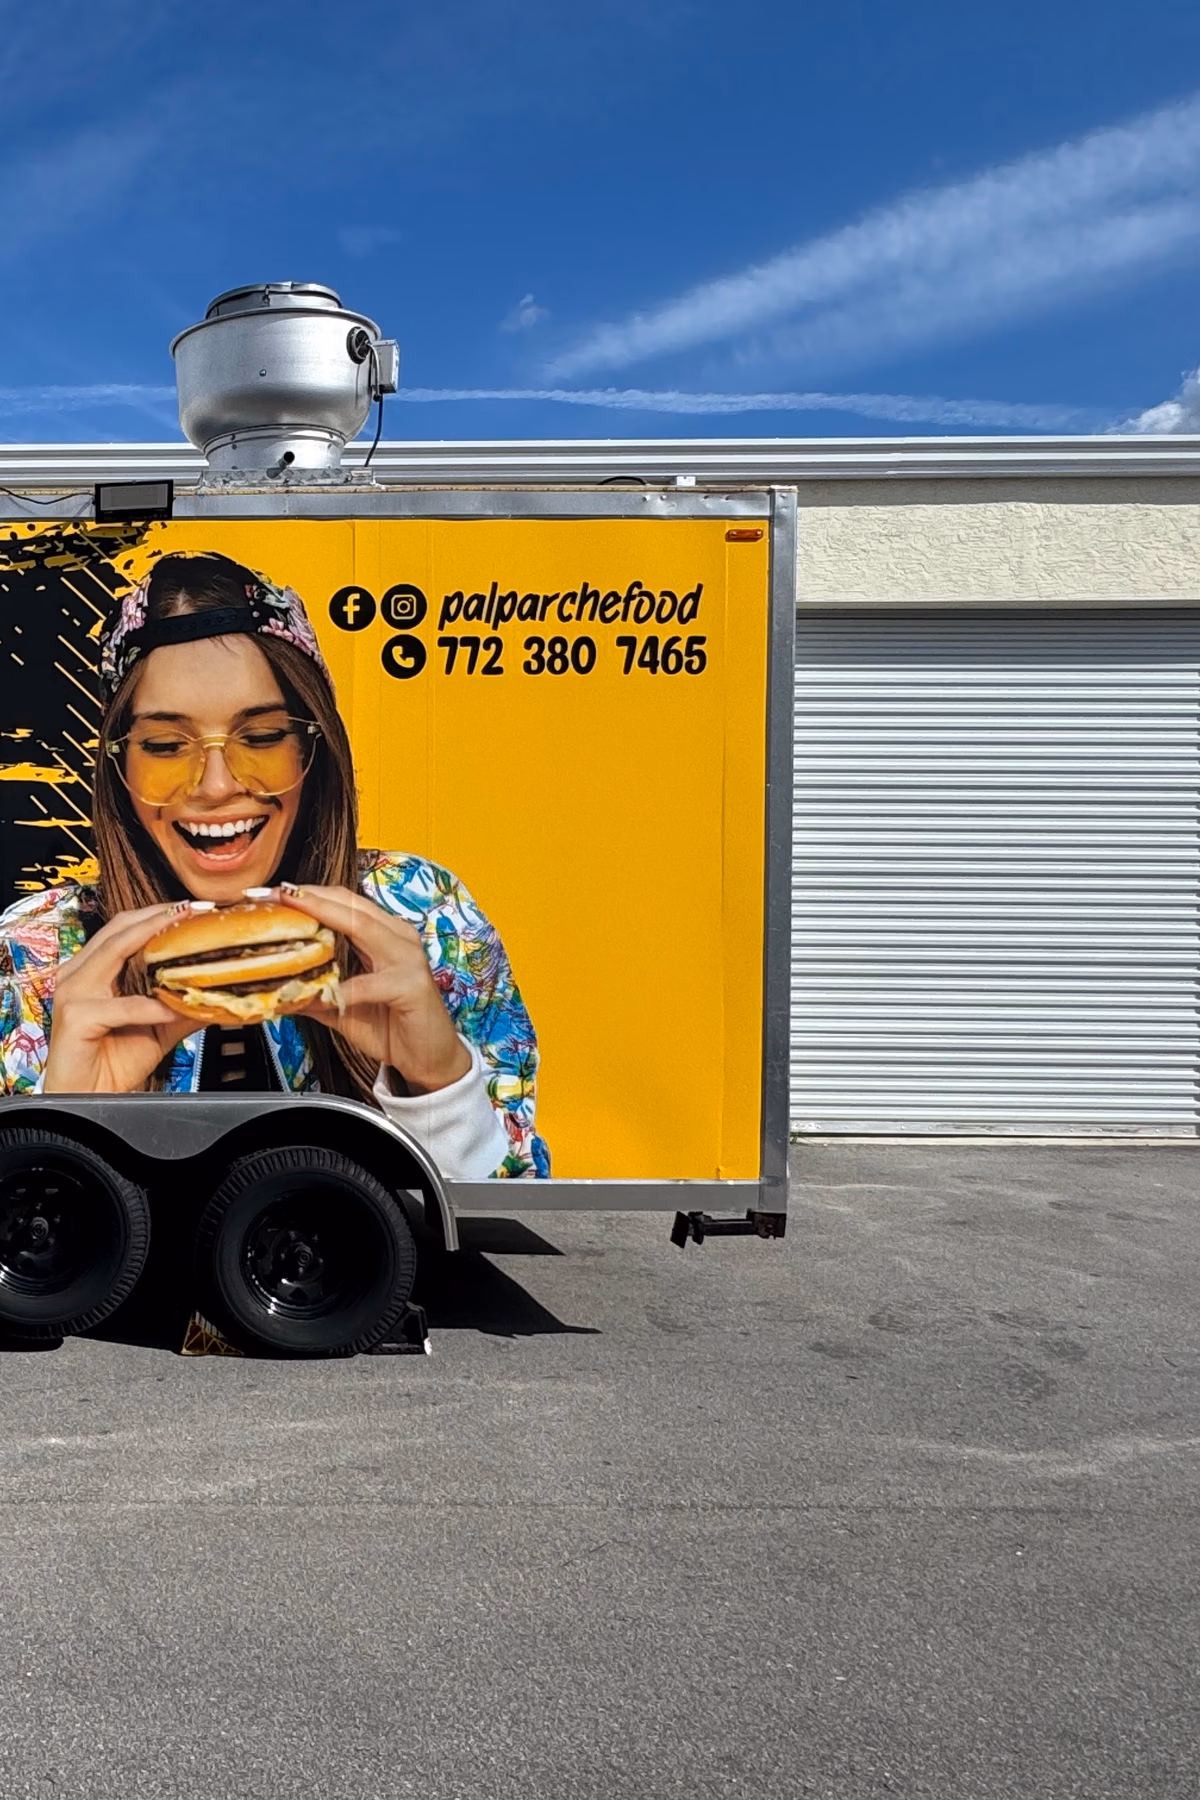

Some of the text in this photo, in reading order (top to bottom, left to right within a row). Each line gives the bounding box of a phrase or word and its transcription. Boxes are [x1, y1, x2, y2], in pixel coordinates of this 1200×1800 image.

[438, 581, 704, 631] palparchefood
[437, 635, 708, 676] 772 380 7465
